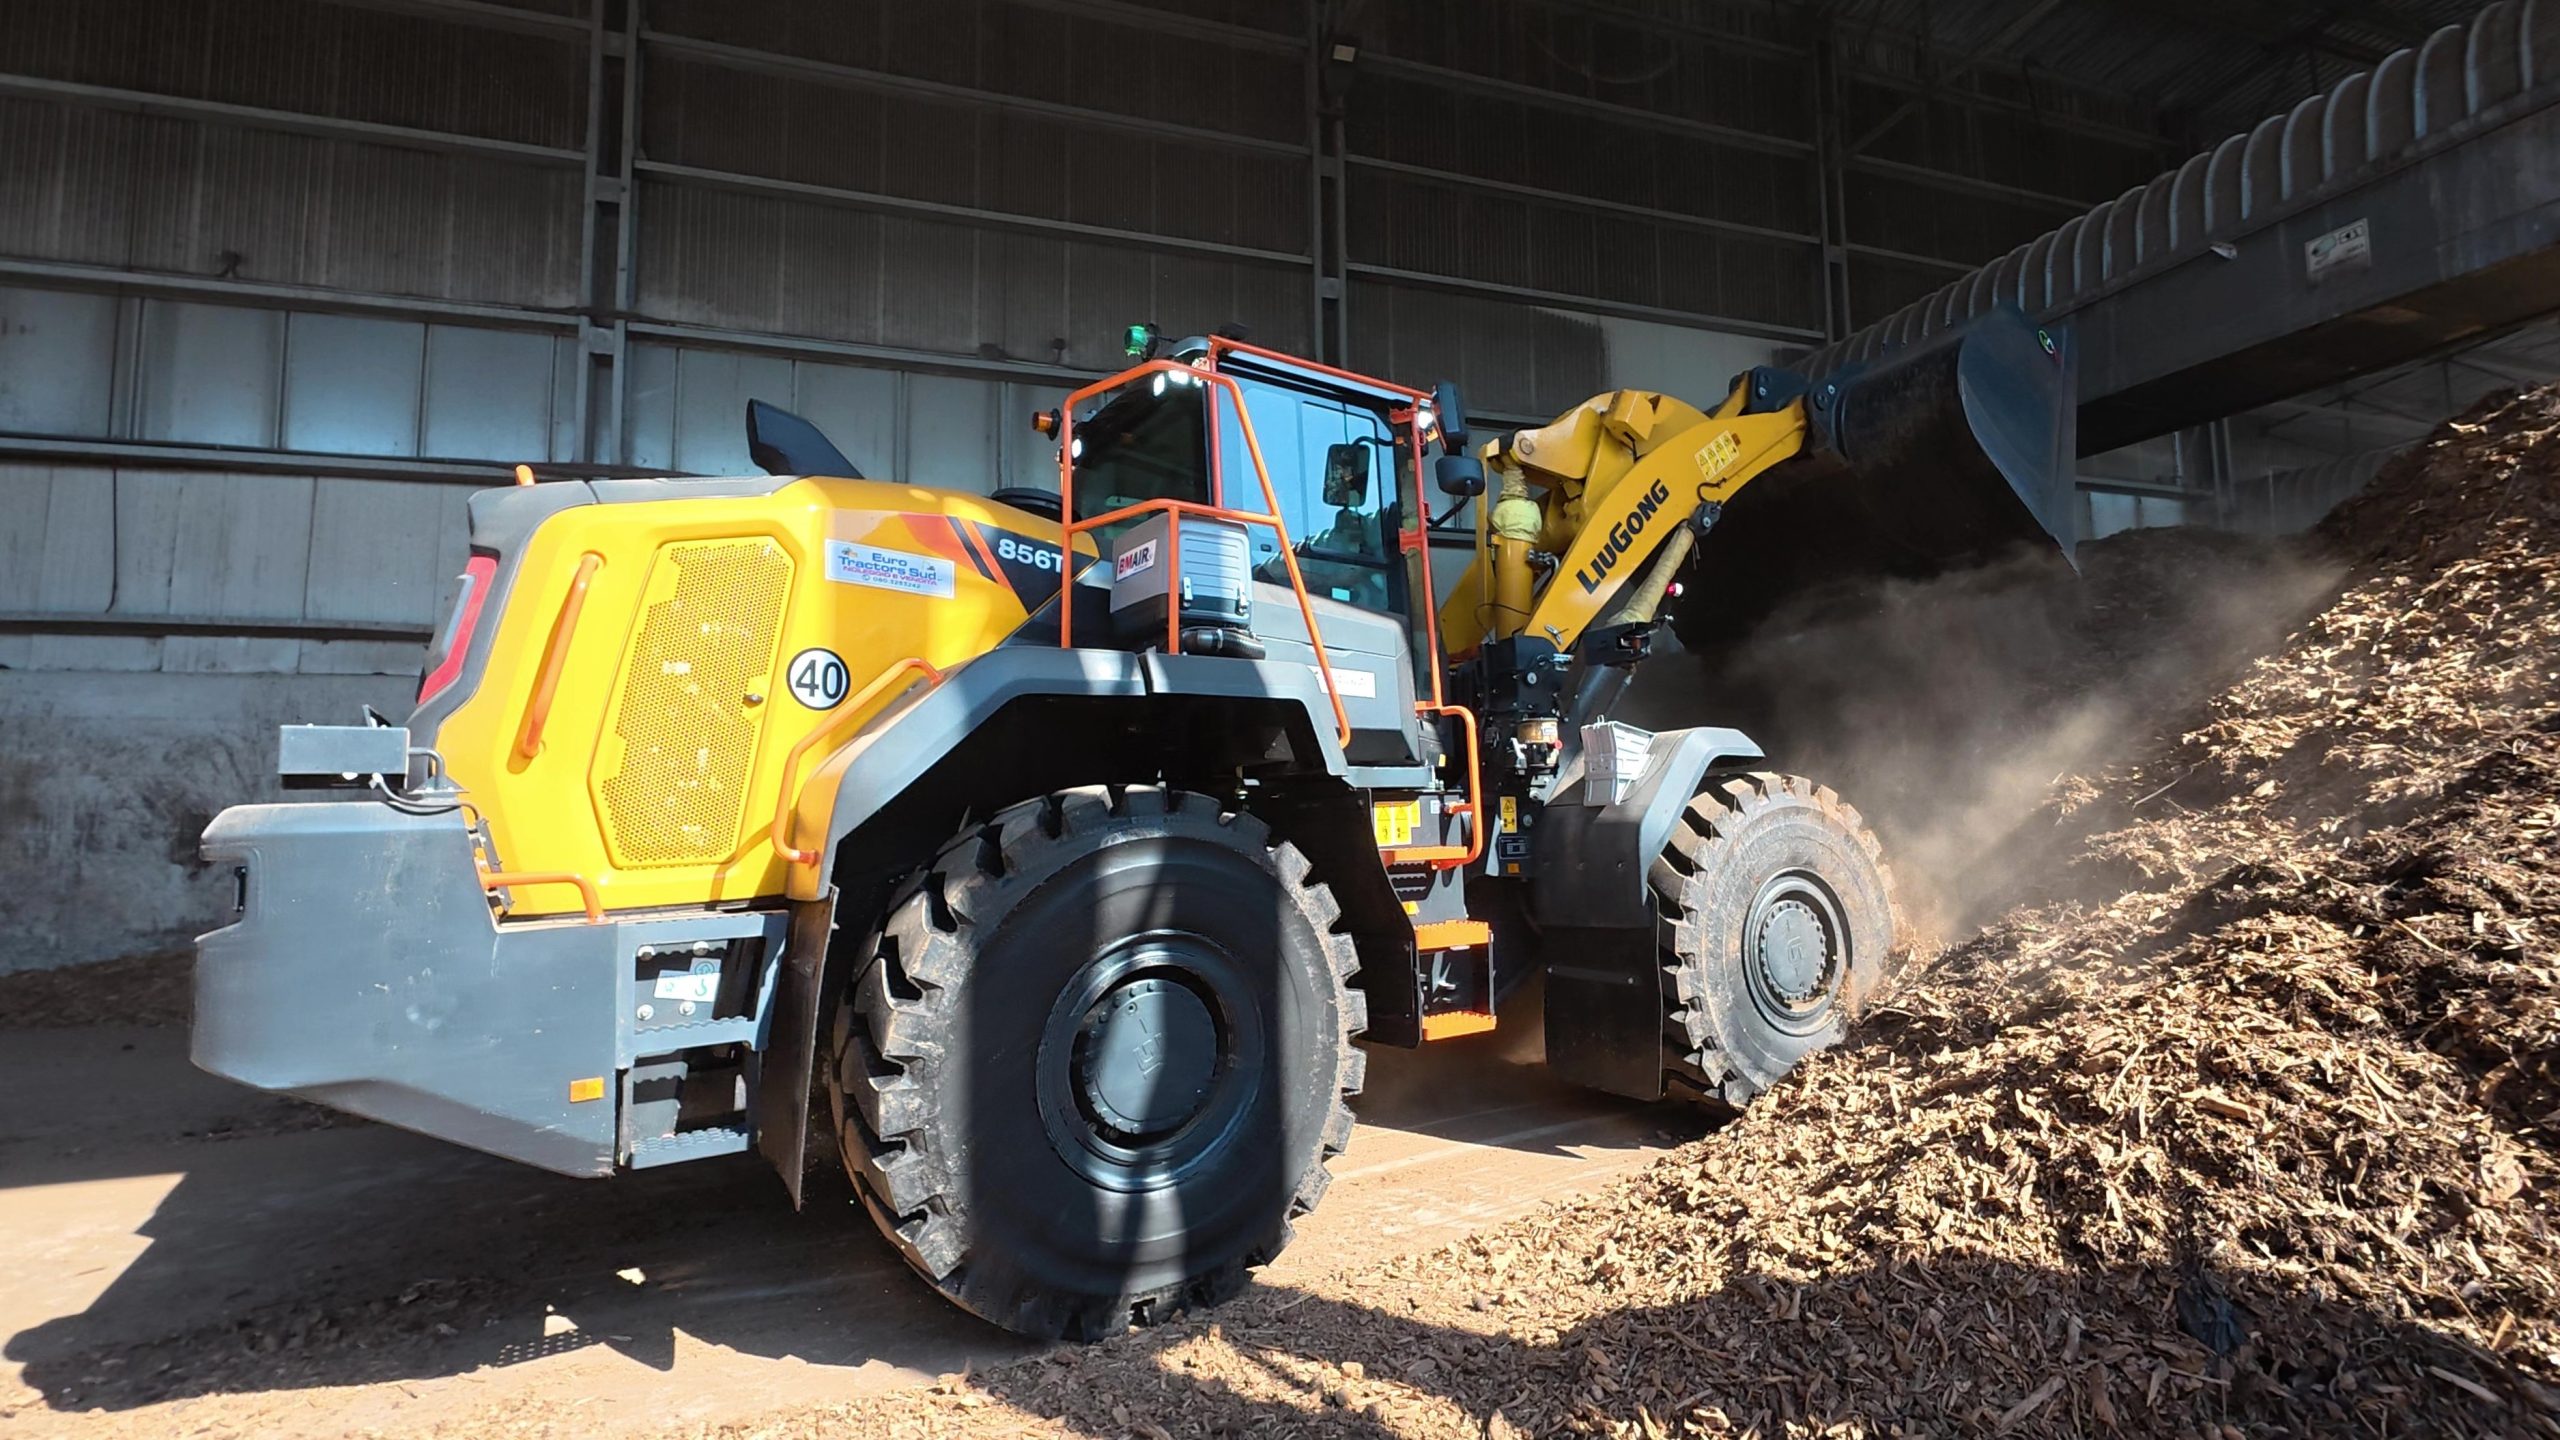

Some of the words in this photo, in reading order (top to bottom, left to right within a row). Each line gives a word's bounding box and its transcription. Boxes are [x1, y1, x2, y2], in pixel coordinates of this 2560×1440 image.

[838, 555, 906, 575] Tractors
[909, 567, 937, 580] Sud
[872, 552, 908, 567] Euro
[998, 538, 1064, 573] 856T
[1119, 547, 1149, 574] BMAIR
[843, 566, 891, 578] NOLEGGIO
[900, 575, 938, 586] VENDITA
[795, 659, 843, 700] 40
